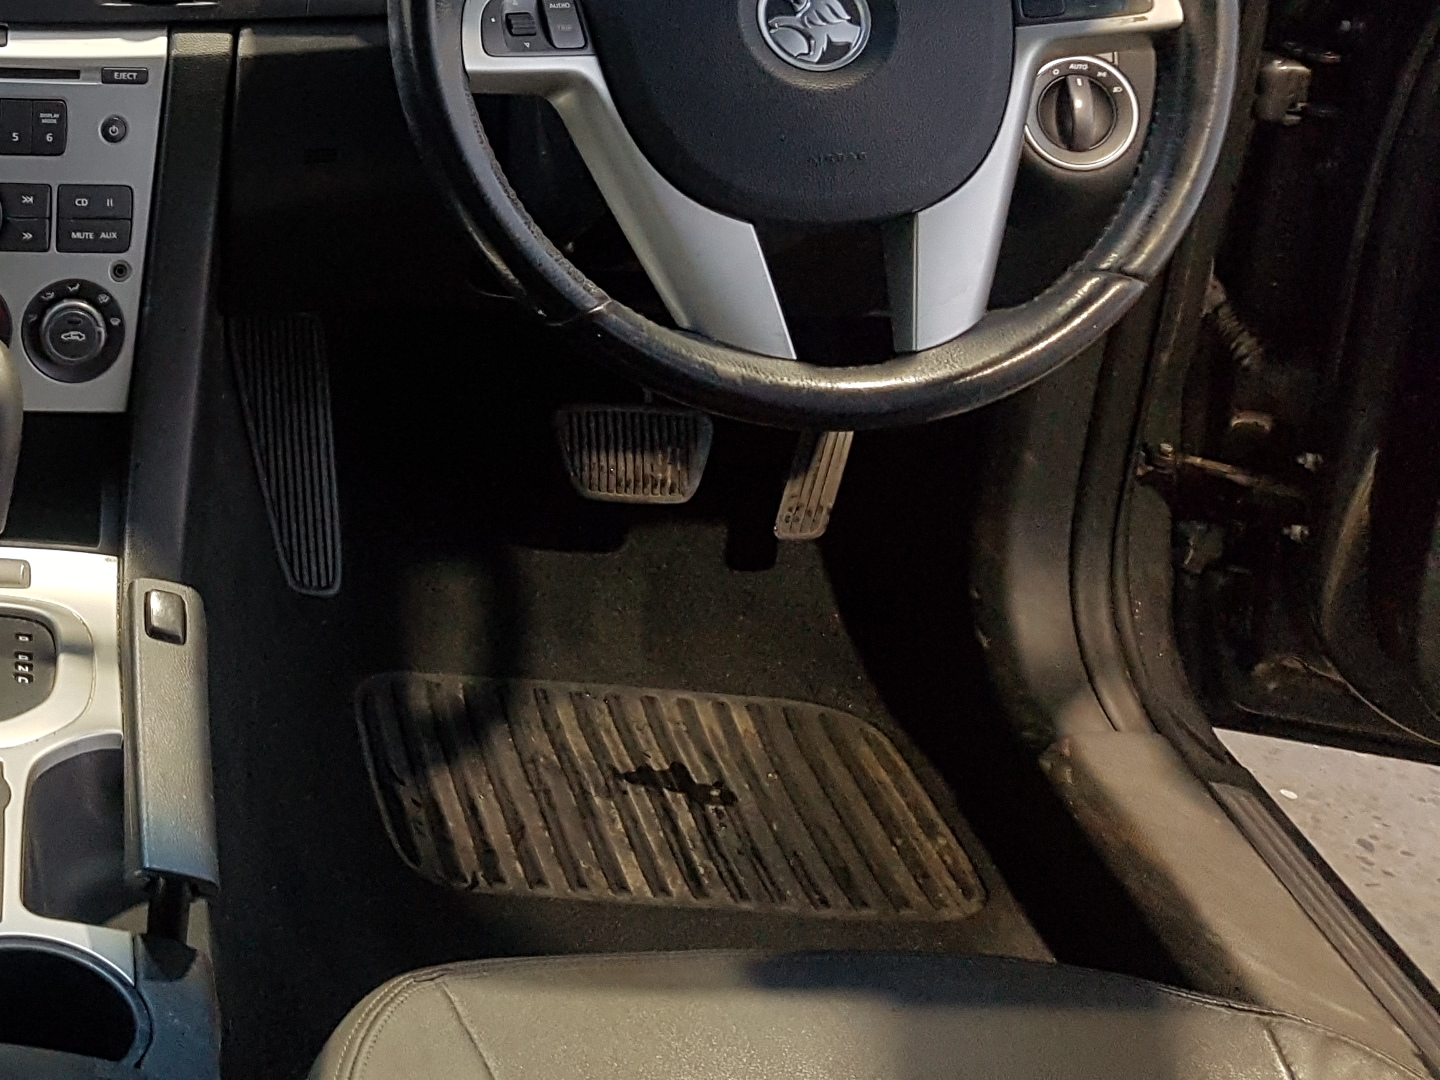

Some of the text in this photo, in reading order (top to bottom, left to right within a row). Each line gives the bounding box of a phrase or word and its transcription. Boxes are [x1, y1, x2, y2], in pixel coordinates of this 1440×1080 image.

[1068, 63, 1089, 71] AUTO
[113, 72, 138, 80] EJECT
[11, 132, 19, 141] 5
[45, 133, 53, 142] 6
[74, 198, 89, 207] CD
[71, 231, 94, 239] MUTE
